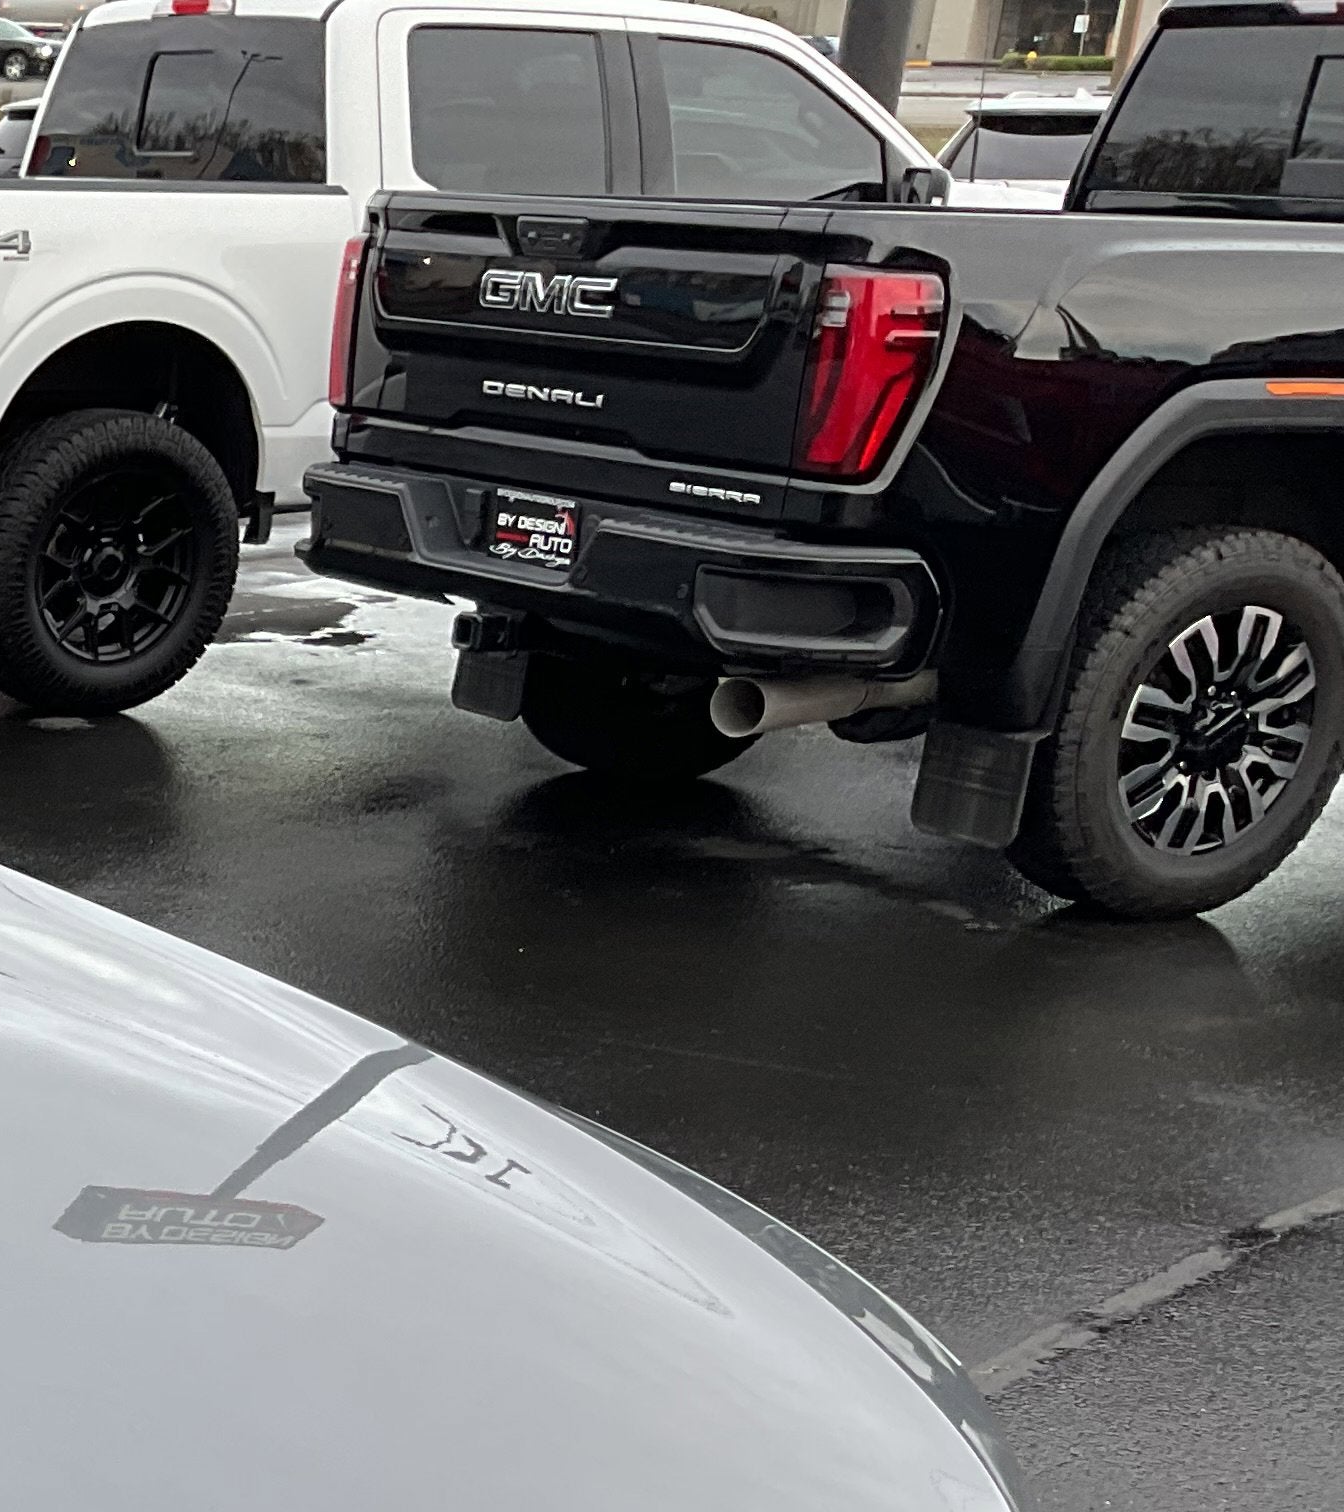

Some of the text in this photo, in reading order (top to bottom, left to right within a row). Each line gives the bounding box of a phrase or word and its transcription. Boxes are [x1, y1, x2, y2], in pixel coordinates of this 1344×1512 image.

[479, 269, 618, 318] GMC
[482, 380, 605, 408] DENALI
[669, 481, 761, 504] SIERRA
[497, 512, 568, 536] BY DESIGN
[529, 533, 573, 554] AUTO
